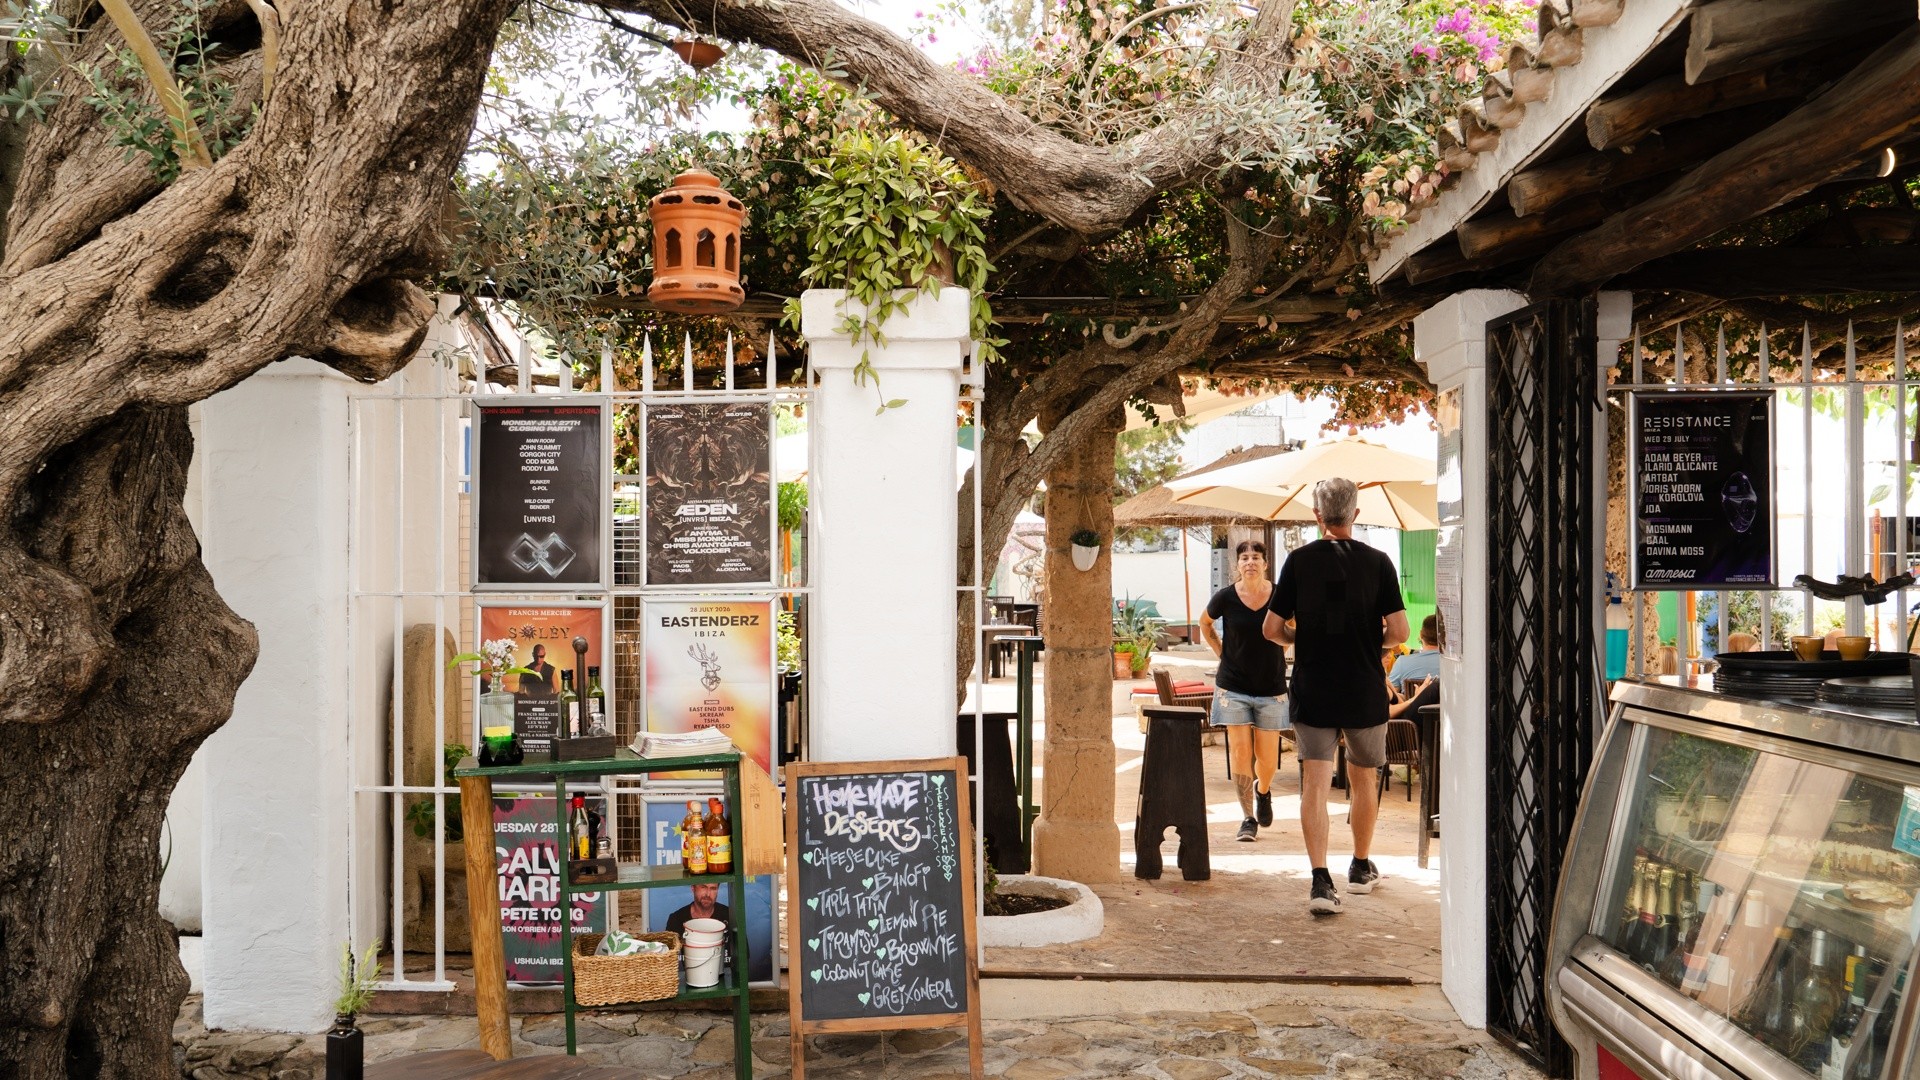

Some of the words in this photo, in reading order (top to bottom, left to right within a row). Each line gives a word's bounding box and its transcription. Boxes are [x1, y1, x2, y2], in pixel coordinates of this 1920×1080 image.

[1644, 416, 1731, 428] RESISTANCE
[1645, 454, 1669, 462] ADAM
[1673, 453, 1701, 461] BEYER
[1645, 463, 1672, 471] ILARIO
[1676, 462, 1718, 470] ALICANTE
[1645, 473, 1678, 482] ARTBAT
[1645, 485, 1668, 493] JORIS
[1671, 484, 1701, 493] VOORN
[1659, 493, 1704, 502] KOROLOVA
[1645, 504, 1661, 513] JOA
[524, 515, 555, 523] [UNVRS]
[1646, 524, 1692, 533] MOSIMANN
[1646, 547, 1677, 555] DAVINA
[1680, 546, 1704, 555] MOSS
[1645, 569, 1696, 578] amnesia
[661, 615, 759, 627] EASTENDERZ
[494, 823, 538, 832] UESDAY
[824, 811, 920, 853] DESSERTS
[817, 887, 851, 917] TARTA
[852, 891, 891, 918] TATIN
[501, 908, 538, 920] PETE
[541, 908, 584, 920] TOG
[878, 896, 918, 942] LEMON
[921, 903, 947, 936] PIE
[886, 934, 957, 966] BROWNIE
[549, 957, 564, 965] IBIZ
[822, 958, 870, 988] COCONUT
[872, 960, 902, 987] CAKE
[873, 977, 957, 1014] GREIXONERA
